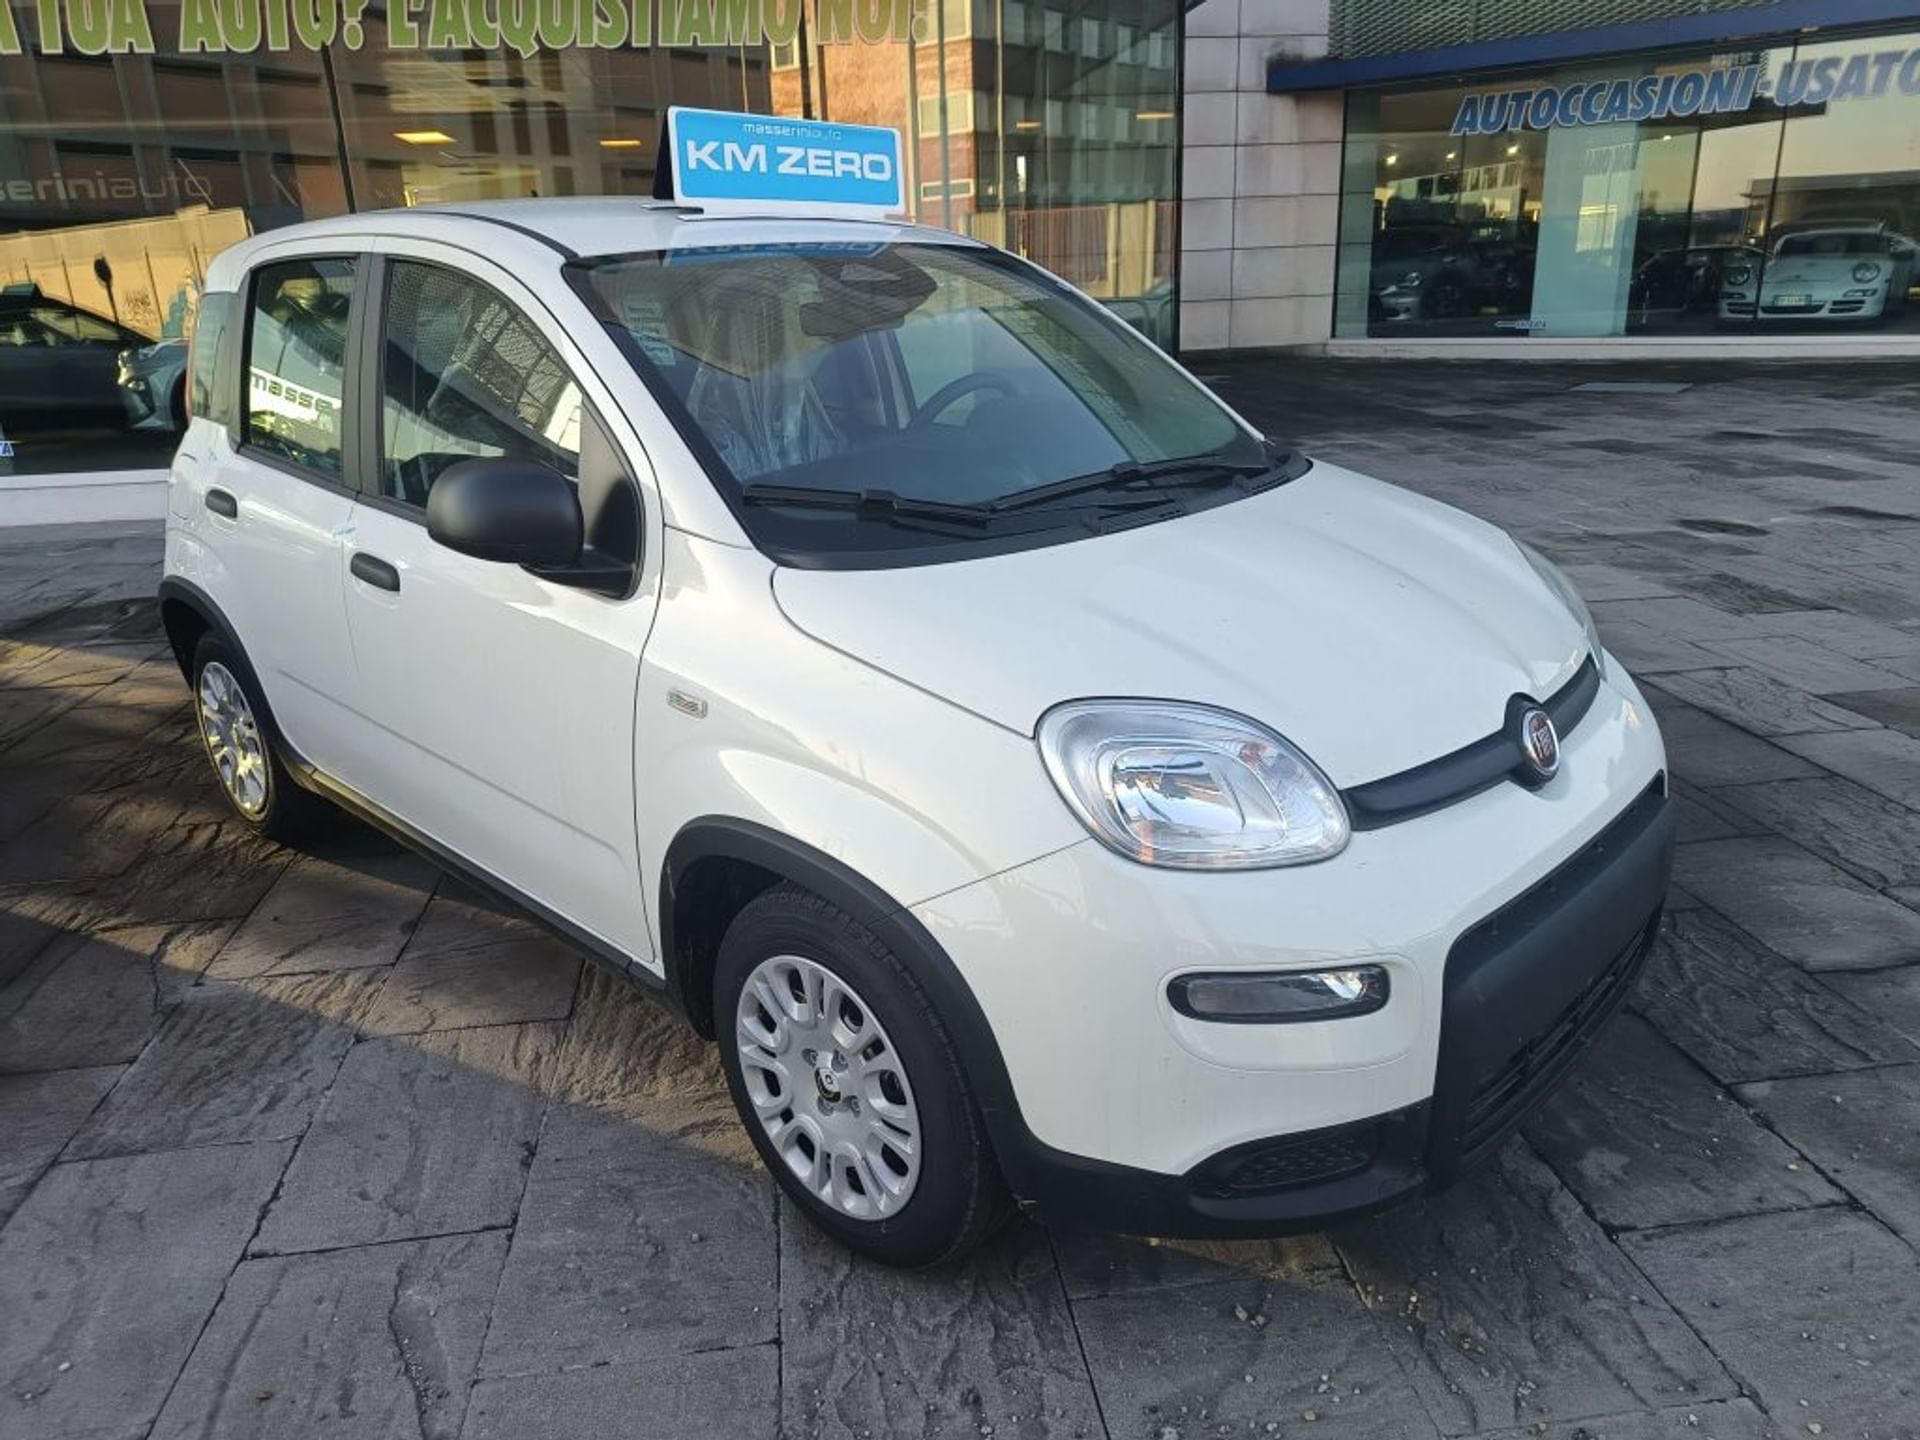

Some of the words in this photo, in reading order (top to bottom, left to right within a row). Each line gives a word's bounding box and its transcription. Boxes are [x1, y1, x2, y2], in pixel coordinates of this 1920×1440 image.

[179, 0, 364, 52] AUTO?
[687, 140, 767, 173] KM
[776, 146, 892, 181] ZERO
[0, 171, 211, 200] eriniauto
